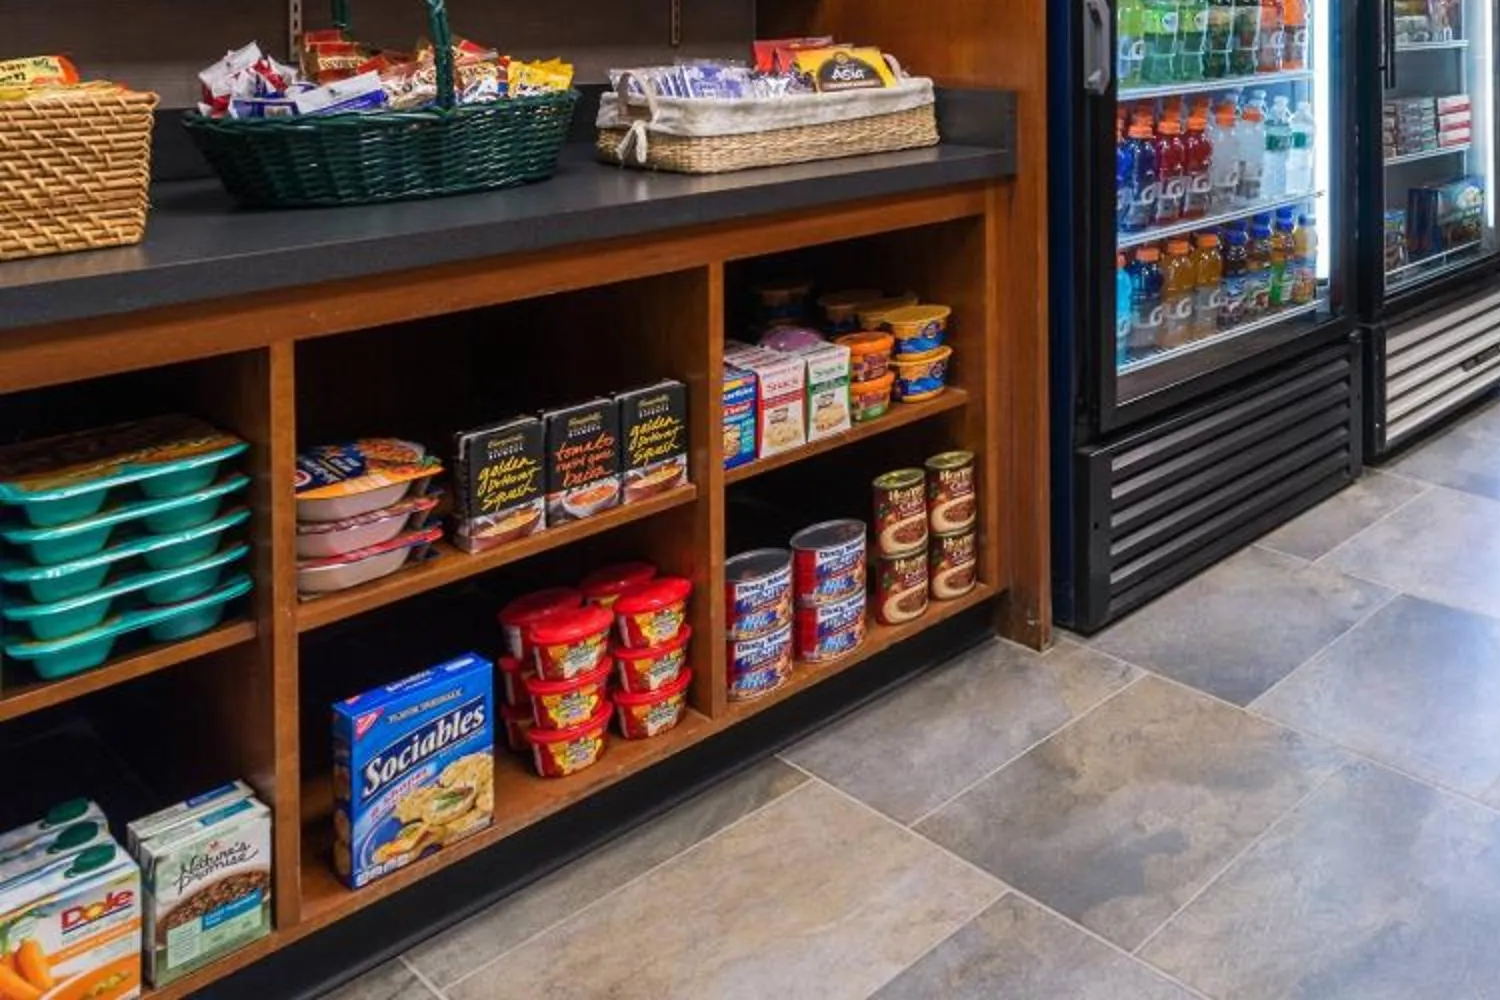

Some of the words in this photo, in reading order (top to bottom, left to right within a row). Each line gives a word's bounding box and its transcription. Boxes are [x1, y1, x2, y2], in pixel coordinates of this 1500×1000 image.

[363, 702, 486, 797] Sociables
[180, 841, 252, 877] Nature's
[61, 888, 134, 931] Dole
